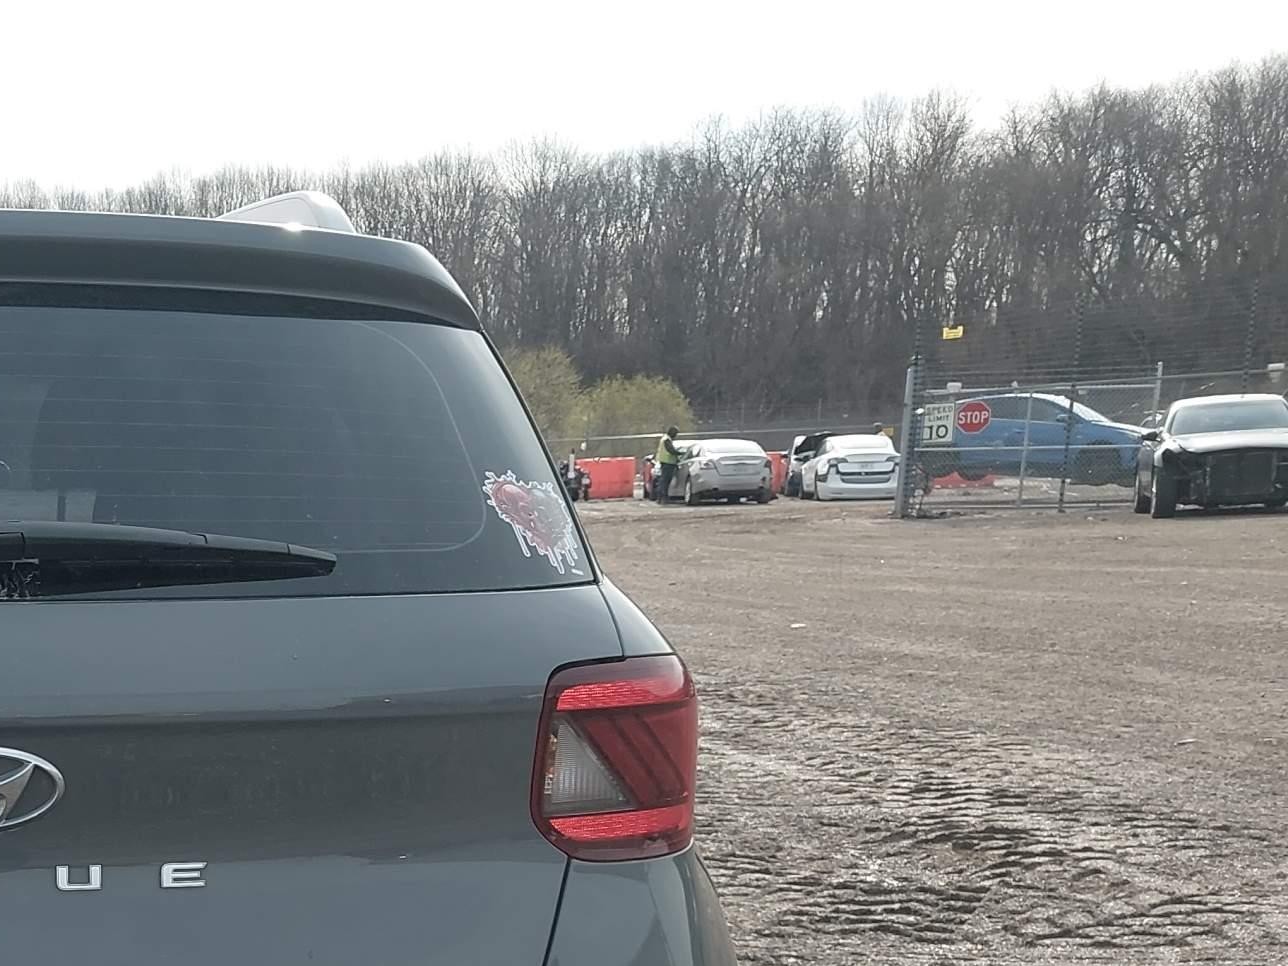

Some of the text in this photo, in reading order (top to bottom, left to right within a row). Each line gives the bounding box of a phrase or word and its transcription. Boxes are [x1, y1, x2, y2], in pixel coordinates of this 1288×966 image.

[928, 414, 951, 423] LIMIT
[958, 411, 989, 425] STOP
[926, 424, 949, 441] 10
